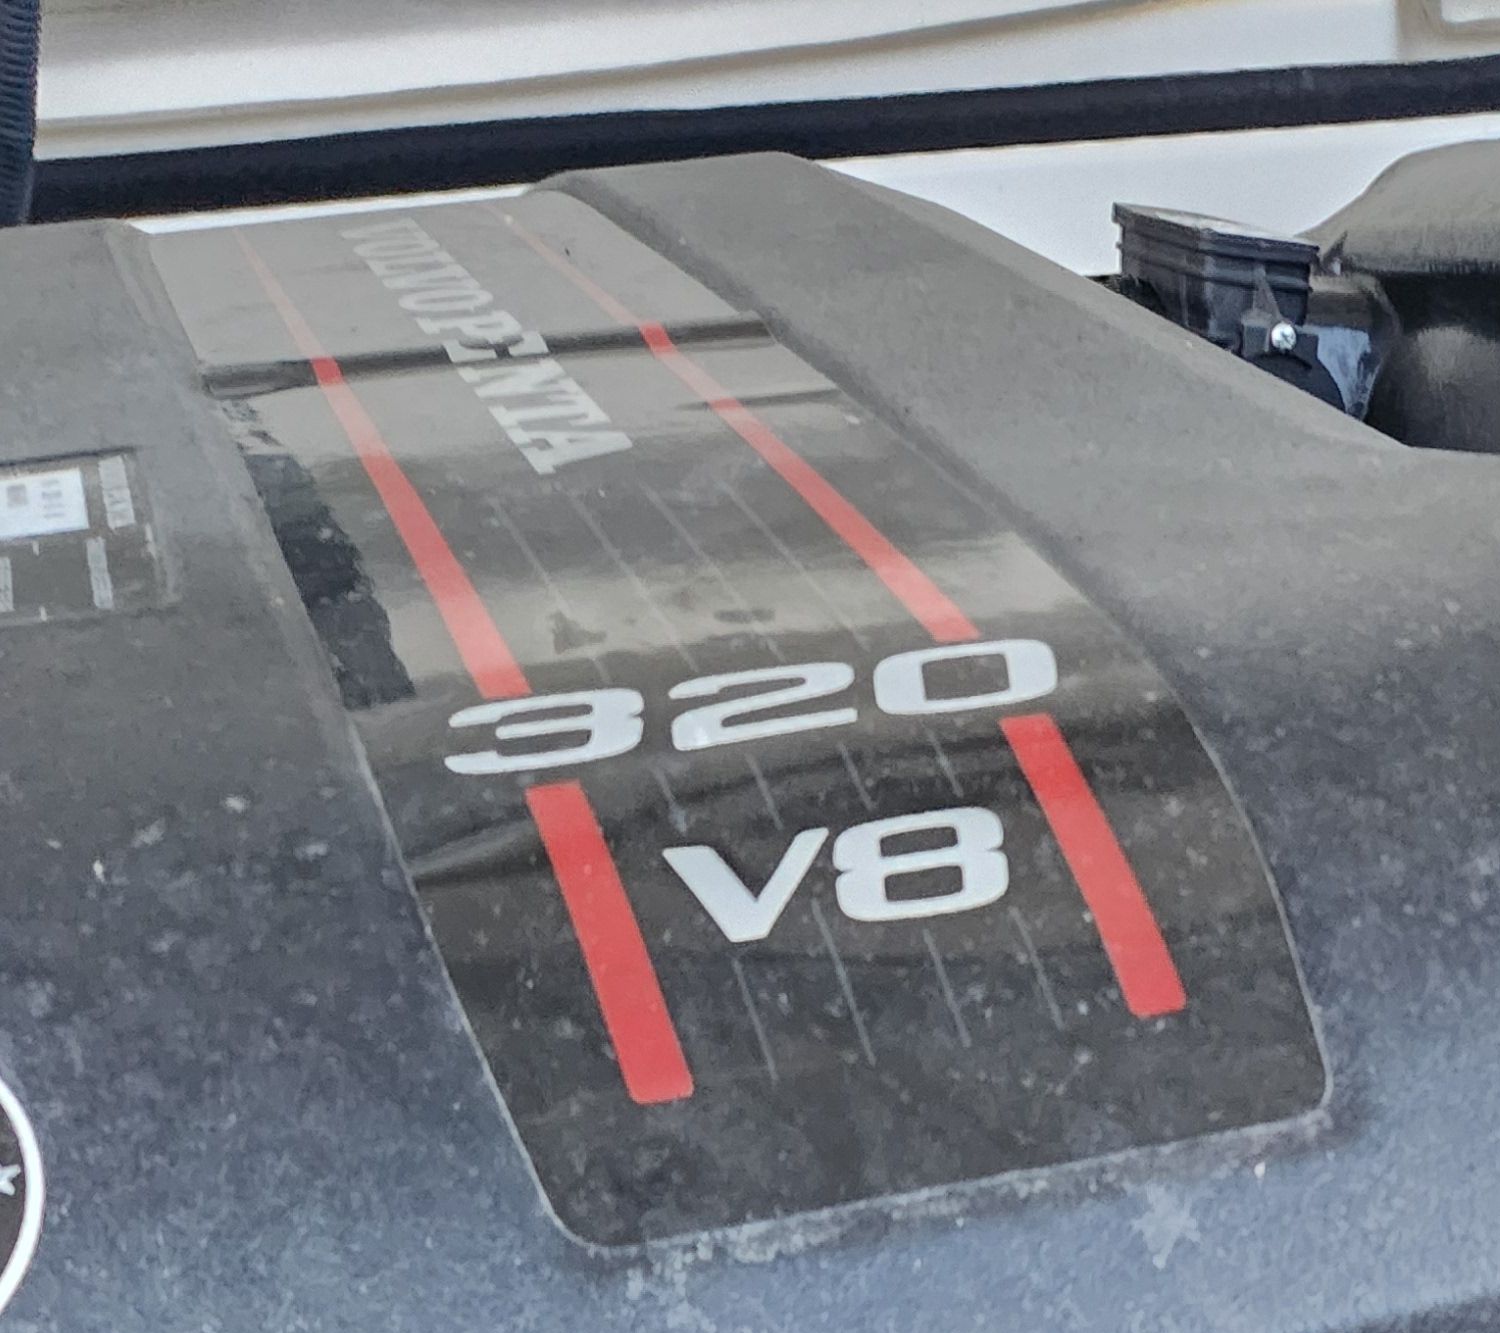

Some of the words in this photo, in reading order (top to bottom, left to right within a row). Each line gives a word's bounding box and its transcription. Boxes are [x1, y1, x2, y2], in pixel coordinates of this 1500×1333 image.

[341, 217, 494, 313] VOLVO
[415, 310, 633, 475] PENTA
[444, 639, 1058, 774] 320
[662, 806, 1010, 942] V8
